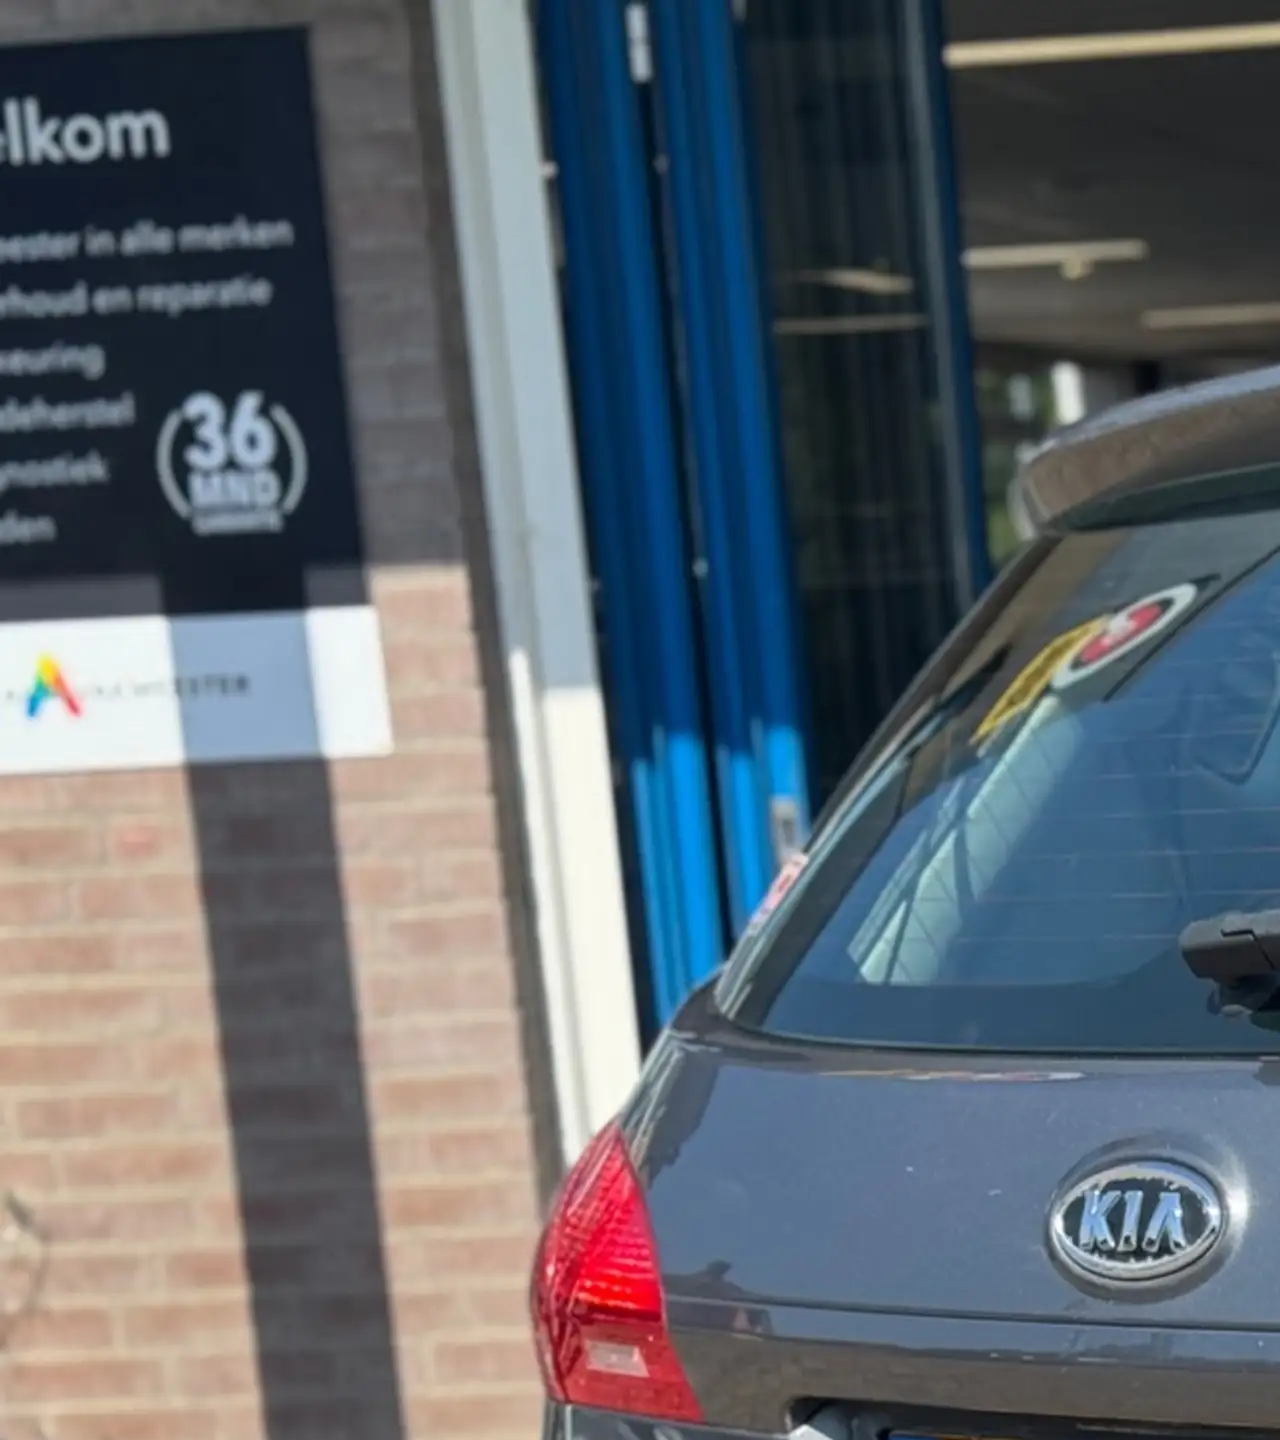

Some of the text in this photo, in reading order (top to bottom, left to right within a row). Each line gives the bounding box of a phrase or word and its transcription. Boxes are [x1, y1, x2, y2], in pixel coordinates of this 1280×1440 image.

[0, 96, 172, 166] lkom
[84, 224, 116, 257] in
[120, 219, 175, 256] alle
[177, 212, 295, 251] merken
[92, 284, 133, 315] en
[137, 273, 274, 318] reparatie
[182, 390, 278, 471] 36
[1078, 1189, 1188, 1253] KIA
